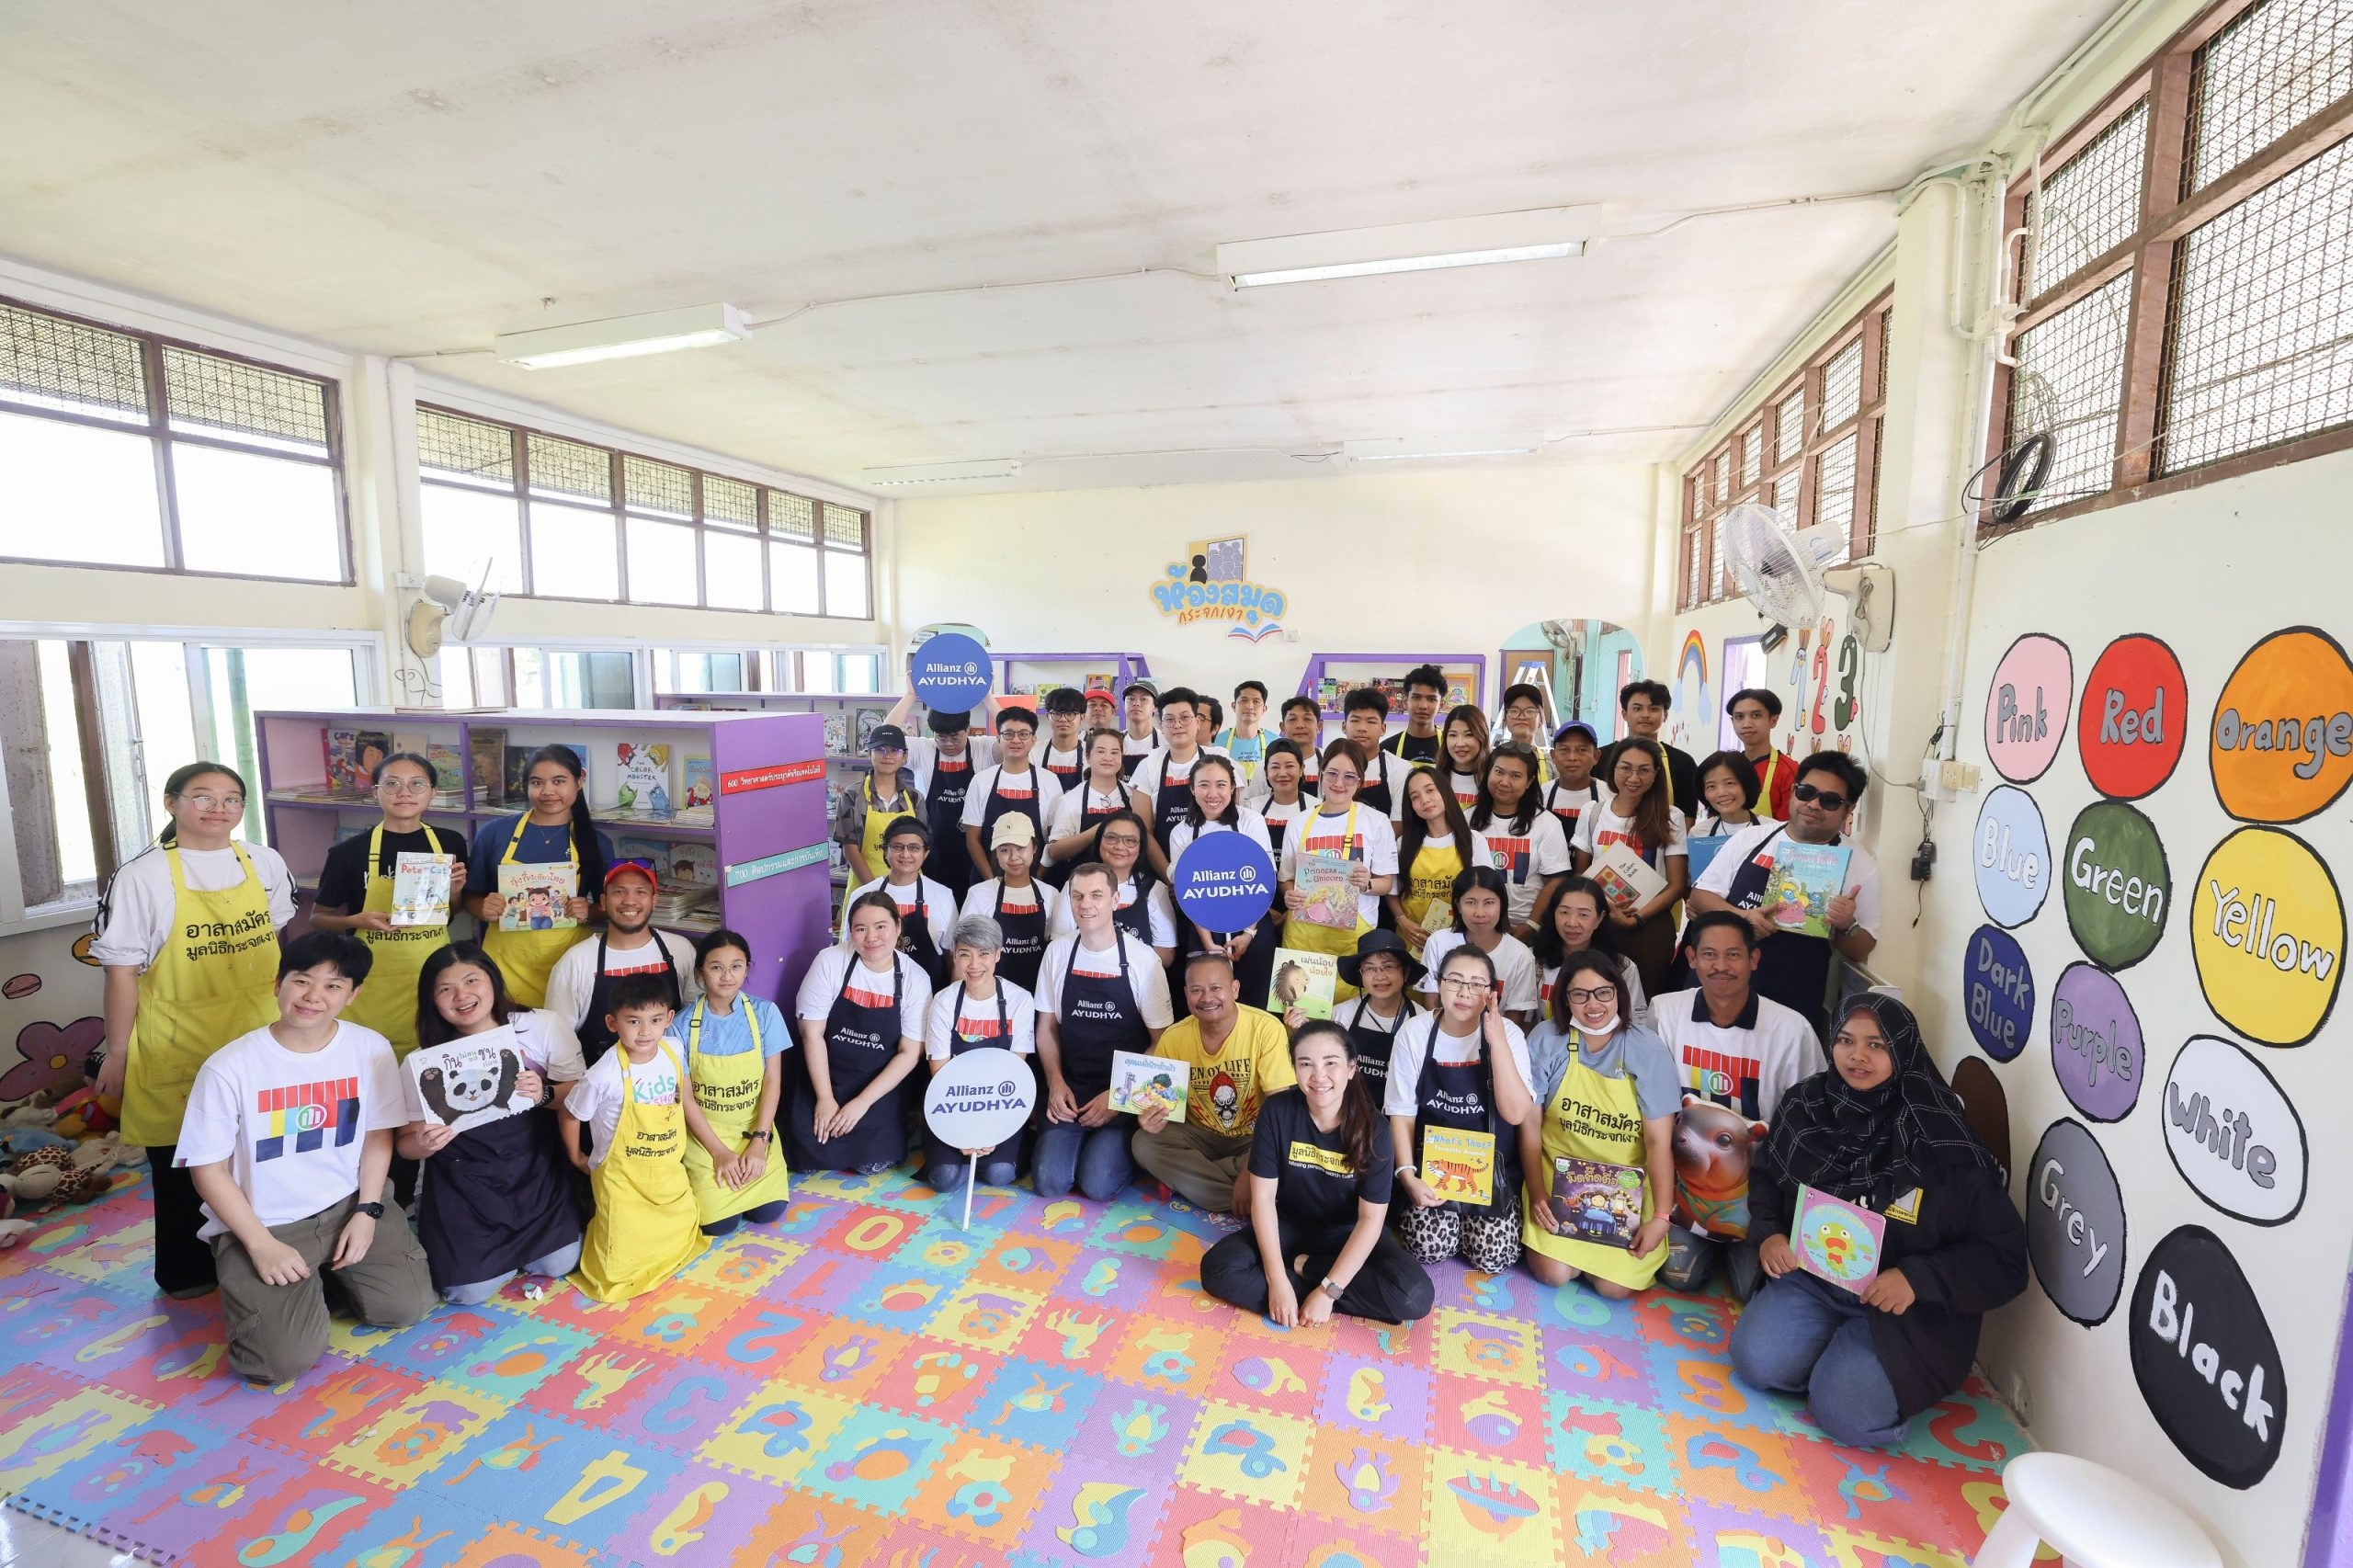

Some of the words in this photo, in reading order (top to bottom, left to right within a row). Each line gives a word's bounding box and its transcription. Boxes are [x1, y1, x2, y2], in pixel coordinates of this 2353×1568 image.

[1154, 564, 1284, 625] ห้องสมุด
[926, 664, 961, 673] Allianz
[917, 676, 986, 686] AYUDHYA
[1996, 684, 2048, 743] Pink
[2100, 687, 2165, 745] Red
[2216, 708, 2353, 779] Orange
[937, 796, 965, 804] AYUDHY
[1981, 816, 2039, 889] Blue
[401, 864, 423, 874] Pete
[429, 866, 449, 875] Cat
[1192, 869, 1236, 882] Allianz
[2071, 836, 2163, 923] Green
[1182, 883, 1269, 900] AYUDHYA
[1746, 891, 1763, 903] Alli
[186, 909, 271, 938] อาสาสมัคร
[2211, 881, 2335, 981] Yellow
[1000, 945, 1042, 954] AYUDHYA
[1006, 937, 1029, 946] Allianz
[1977, 937, 2029, 1009] Dark
[1077, 1000, 1104, 1009] Allianz
[1071, 1009, 1123, 1019] AYUDHYA
[1972, 983, 2016, 1049] Blue
[840, 1027, 868, 1039] Allianz
[832, 1034, 885, 1051] AYUDHYA
[2054, 999, 2132, 1086] Purple
[1357, 1054, 1385, 1067] Allianz
[1190, 1063, 1223, 1081] ENOY
[1225, 1058, 1251, 1074] LIFE
[1356, 1065, 1389, 1079] YUDH
[633, 1074, 676, 1103] Kids
[946, 1085, 994, 1097] Allianz
[931, 1097, 1028, 1115] AYUDHYA
[1426, 1098, 1485, 1115] AYUDHYA
[1561, 1097, 1642, 1132] อาสาสมัคร
[1289, 1160, 1307, 1169] Missing
[1291, 1146, 1344, 1167] มูลนิธิกระจก
[2040, 1159, 2108, 1278] Grey
[2150, 1270, 2273, 1442] Black
